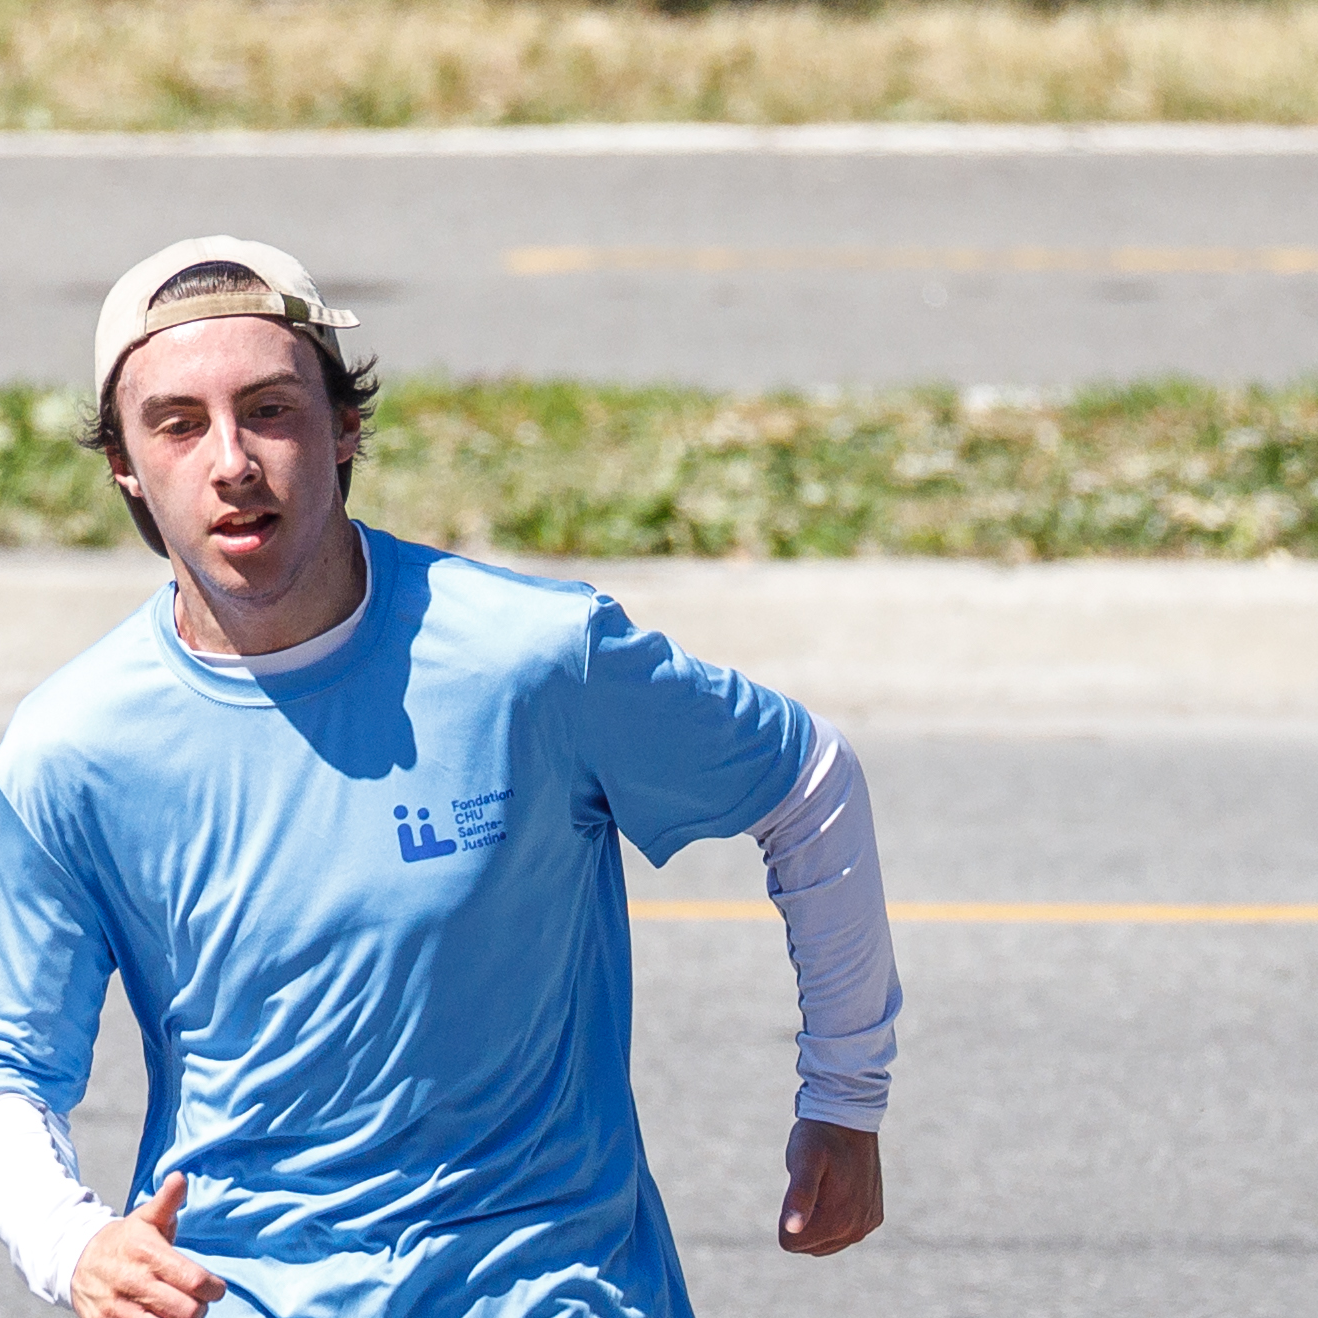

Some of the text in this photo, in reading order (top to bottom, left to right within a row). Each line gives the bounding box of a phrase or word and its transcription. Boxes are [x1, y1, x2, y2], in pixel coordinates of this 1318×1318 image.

[451, 788, 514, 812] Fondation
[455, 808, 483, 824] CHU
[458, 820, 503, 838] Sainte-
[462, 831, 507, 852] Justine
